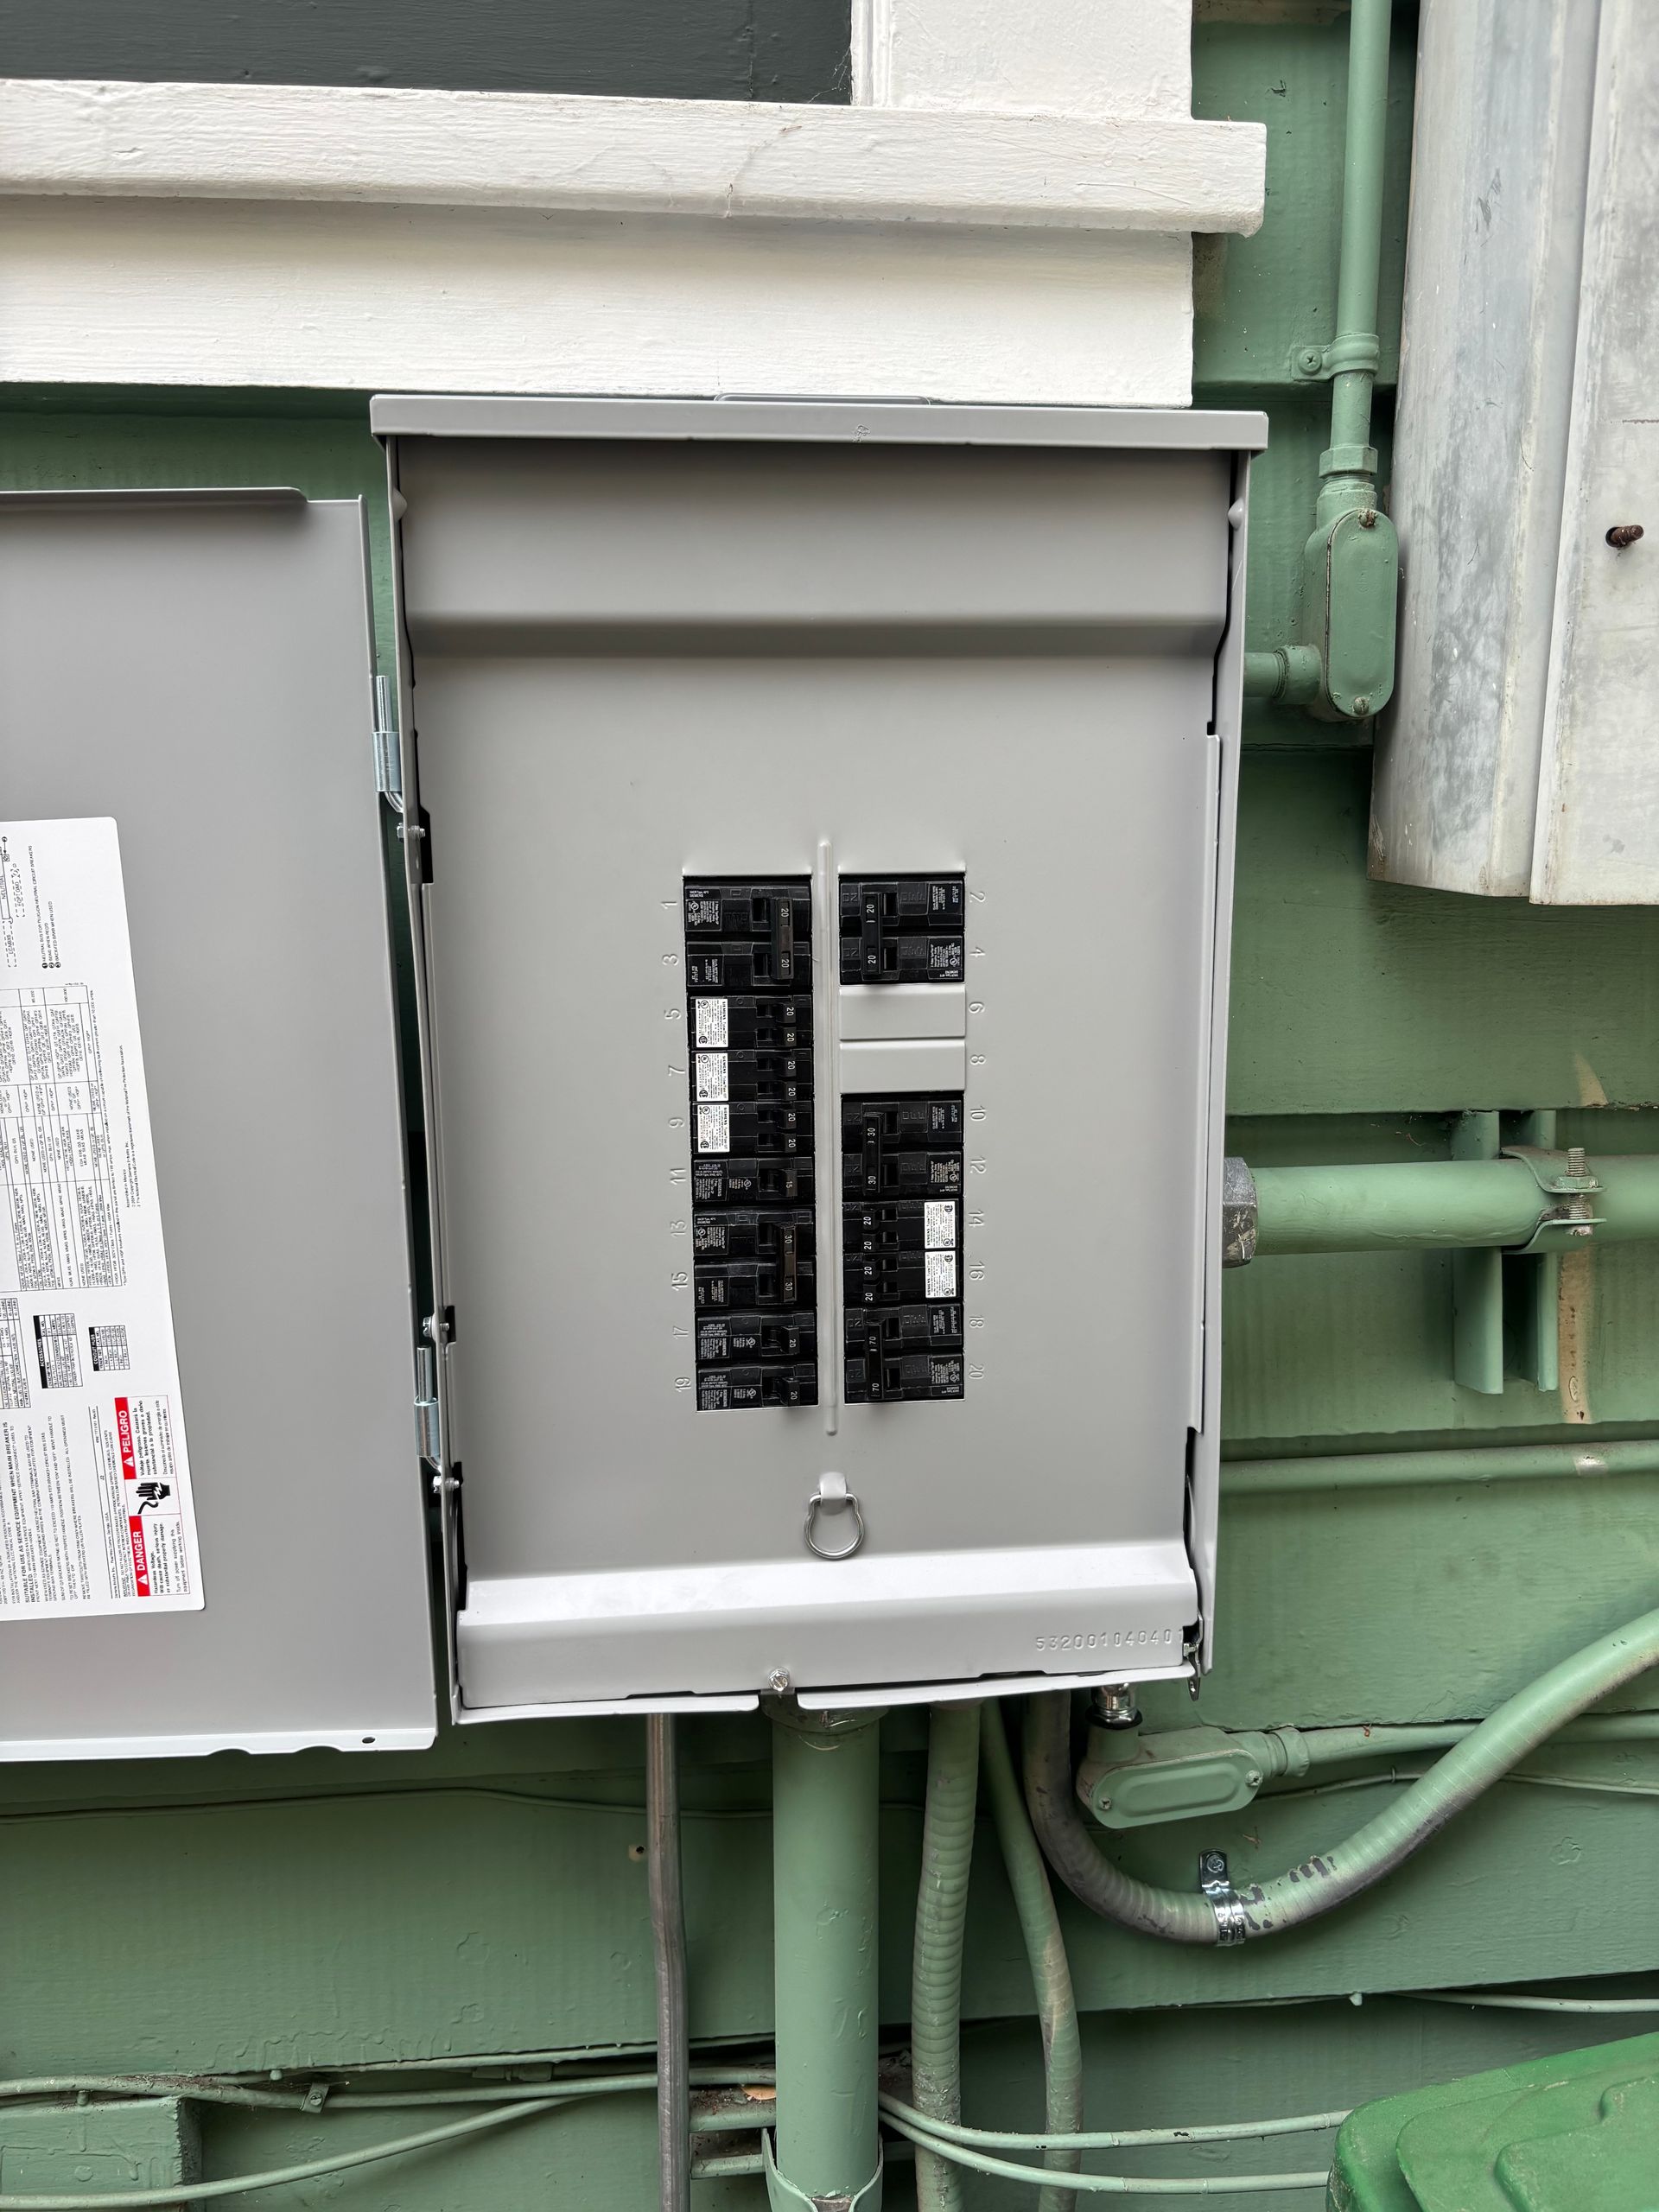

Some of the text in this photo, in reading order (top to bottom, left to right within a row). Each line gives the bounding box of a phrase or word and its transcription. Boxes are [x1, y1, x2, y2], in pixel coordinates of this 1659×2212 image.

[969, 891, 986, 903] 2
[661, 900, 677, 909] 1
[866, 904, 874, 913] 20
[781, 908, 789, 918] 20
[969, 946, 986, 958] 4
[662, 954, 679, 966] 3
[781, 959, 789, 968] 20
[868, 955, 876, 964] 20
[786, 1007, 794, 1016] 20
[969, 1001, 985, 1014] 6
[664, 1008, 681, 1020] 5
[787, 1033, 794, 1042] 20
[969, 1054, 986, 1065] 8
[787, 1061, 796, 1070] 20
[668, 1065, 685, 1077] 7
[788, 1087, 796, 1096] 20
[788, 1113, 796, 1122] 20
[969, 1105, 987, 1122] 10
[669, 1116, 684, 1128] 9
[867, 1127, 876, 1137] 30
[788, 1139, 796, 1147] 20
[969, 1156, 987, 1174] 12
[670, 1167, 687, 1185] 11
[868, 1175, 876, 1185] 30
[786, 1180, 792, 1189] 15
[863, 1216, 872, 1226] 20
[968, 1210, 985, 1227] 14
[671, 1221, 687, 1237] 13
[785, 1235, 792, 1244] 30
[864, 1241, 872, 1250] 20
[865, 1266, 873, 1275] 20
[969, 1262, 985, 1281] 16
[671, 1272, 689, 1292] 15
[785, 1282, 792, 1291] 30
[865, 1293, 874, 1301] 20
[969, 1316, 984, 1329] 18
[672, 1325, 689, 1339] 17
[789, 1339, 797, 1348] 20
[868, 1336, 876, 1344] 70
[969, 1363, 984, 1380] 20
[675, 1376, 691, 1392] 19
[872, 1382, 880, 1392] 70
[790, 1391, 798, 1400] 20
[118, 1410, 131, 1453] PELIGRO
[11, 1488, 20, 1520] EQUIPMENT
[133, 1531, 145, 1571] DANGER
